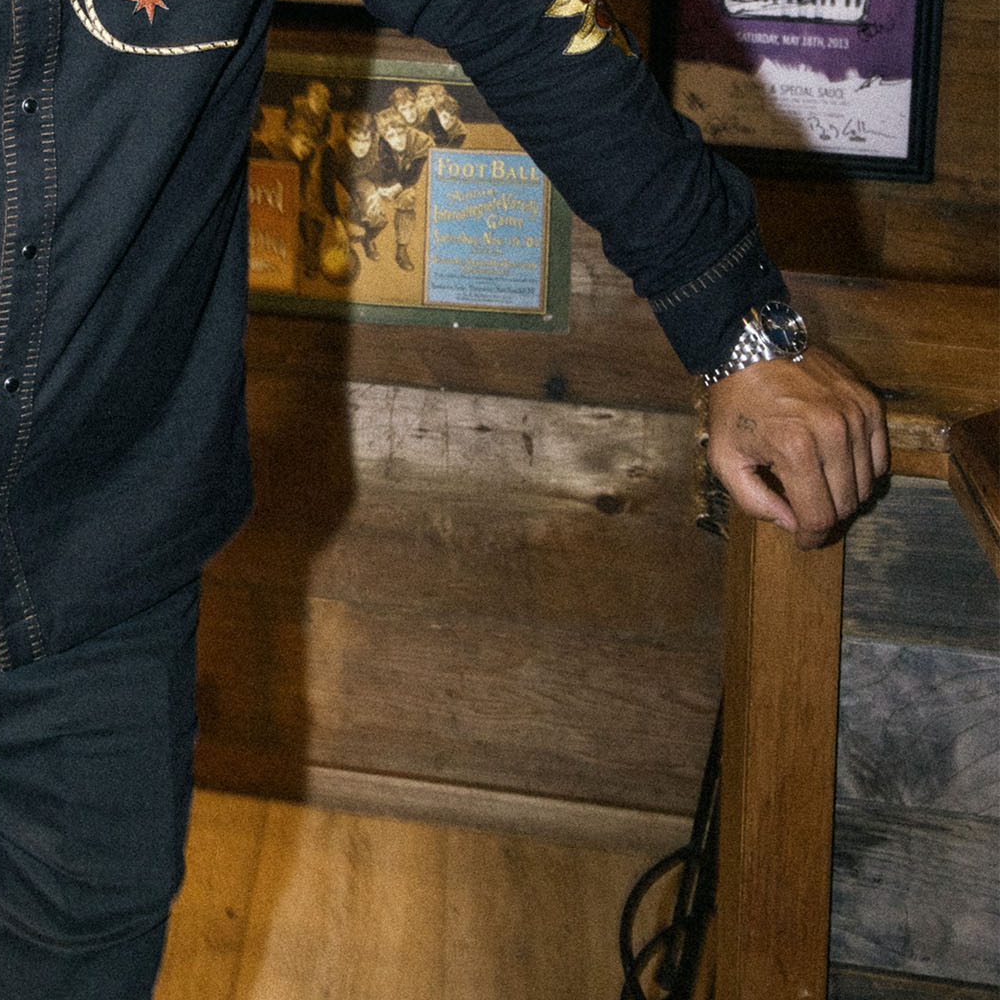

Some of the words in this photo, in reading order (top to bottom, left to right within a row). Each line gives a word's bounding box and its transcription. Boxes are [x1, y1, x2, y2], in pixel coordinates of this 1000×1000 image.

[782, 34, 801, 46] MAY
[827, 37, 850, 49] 2013
[779, 84, 814, 97] SPECIAL
[817, 86, 846, 98] SAUCE
